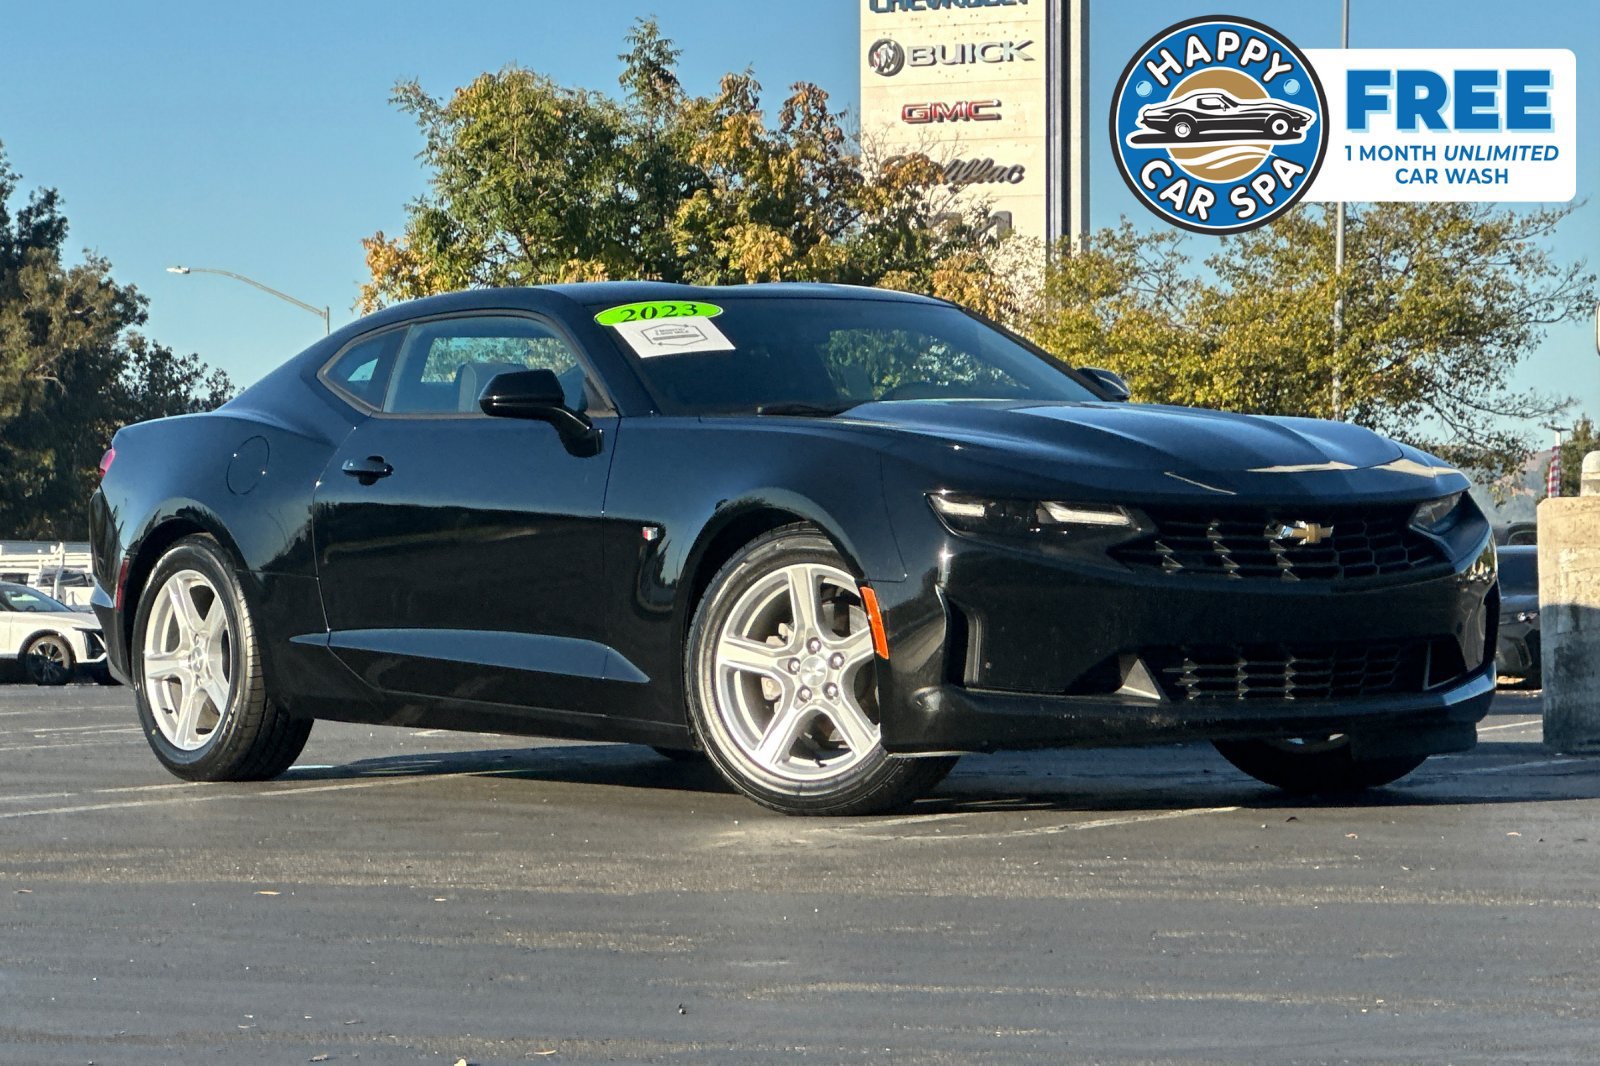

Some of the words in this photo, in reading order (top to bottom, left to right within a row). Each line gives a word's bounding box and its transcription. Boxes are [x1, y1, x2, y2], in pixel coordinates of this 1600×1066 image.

[906, 39, 1036, 67] BUICK
[901, 99, 1002, 124] GMC
[620, 303, 698, 322] 2023
